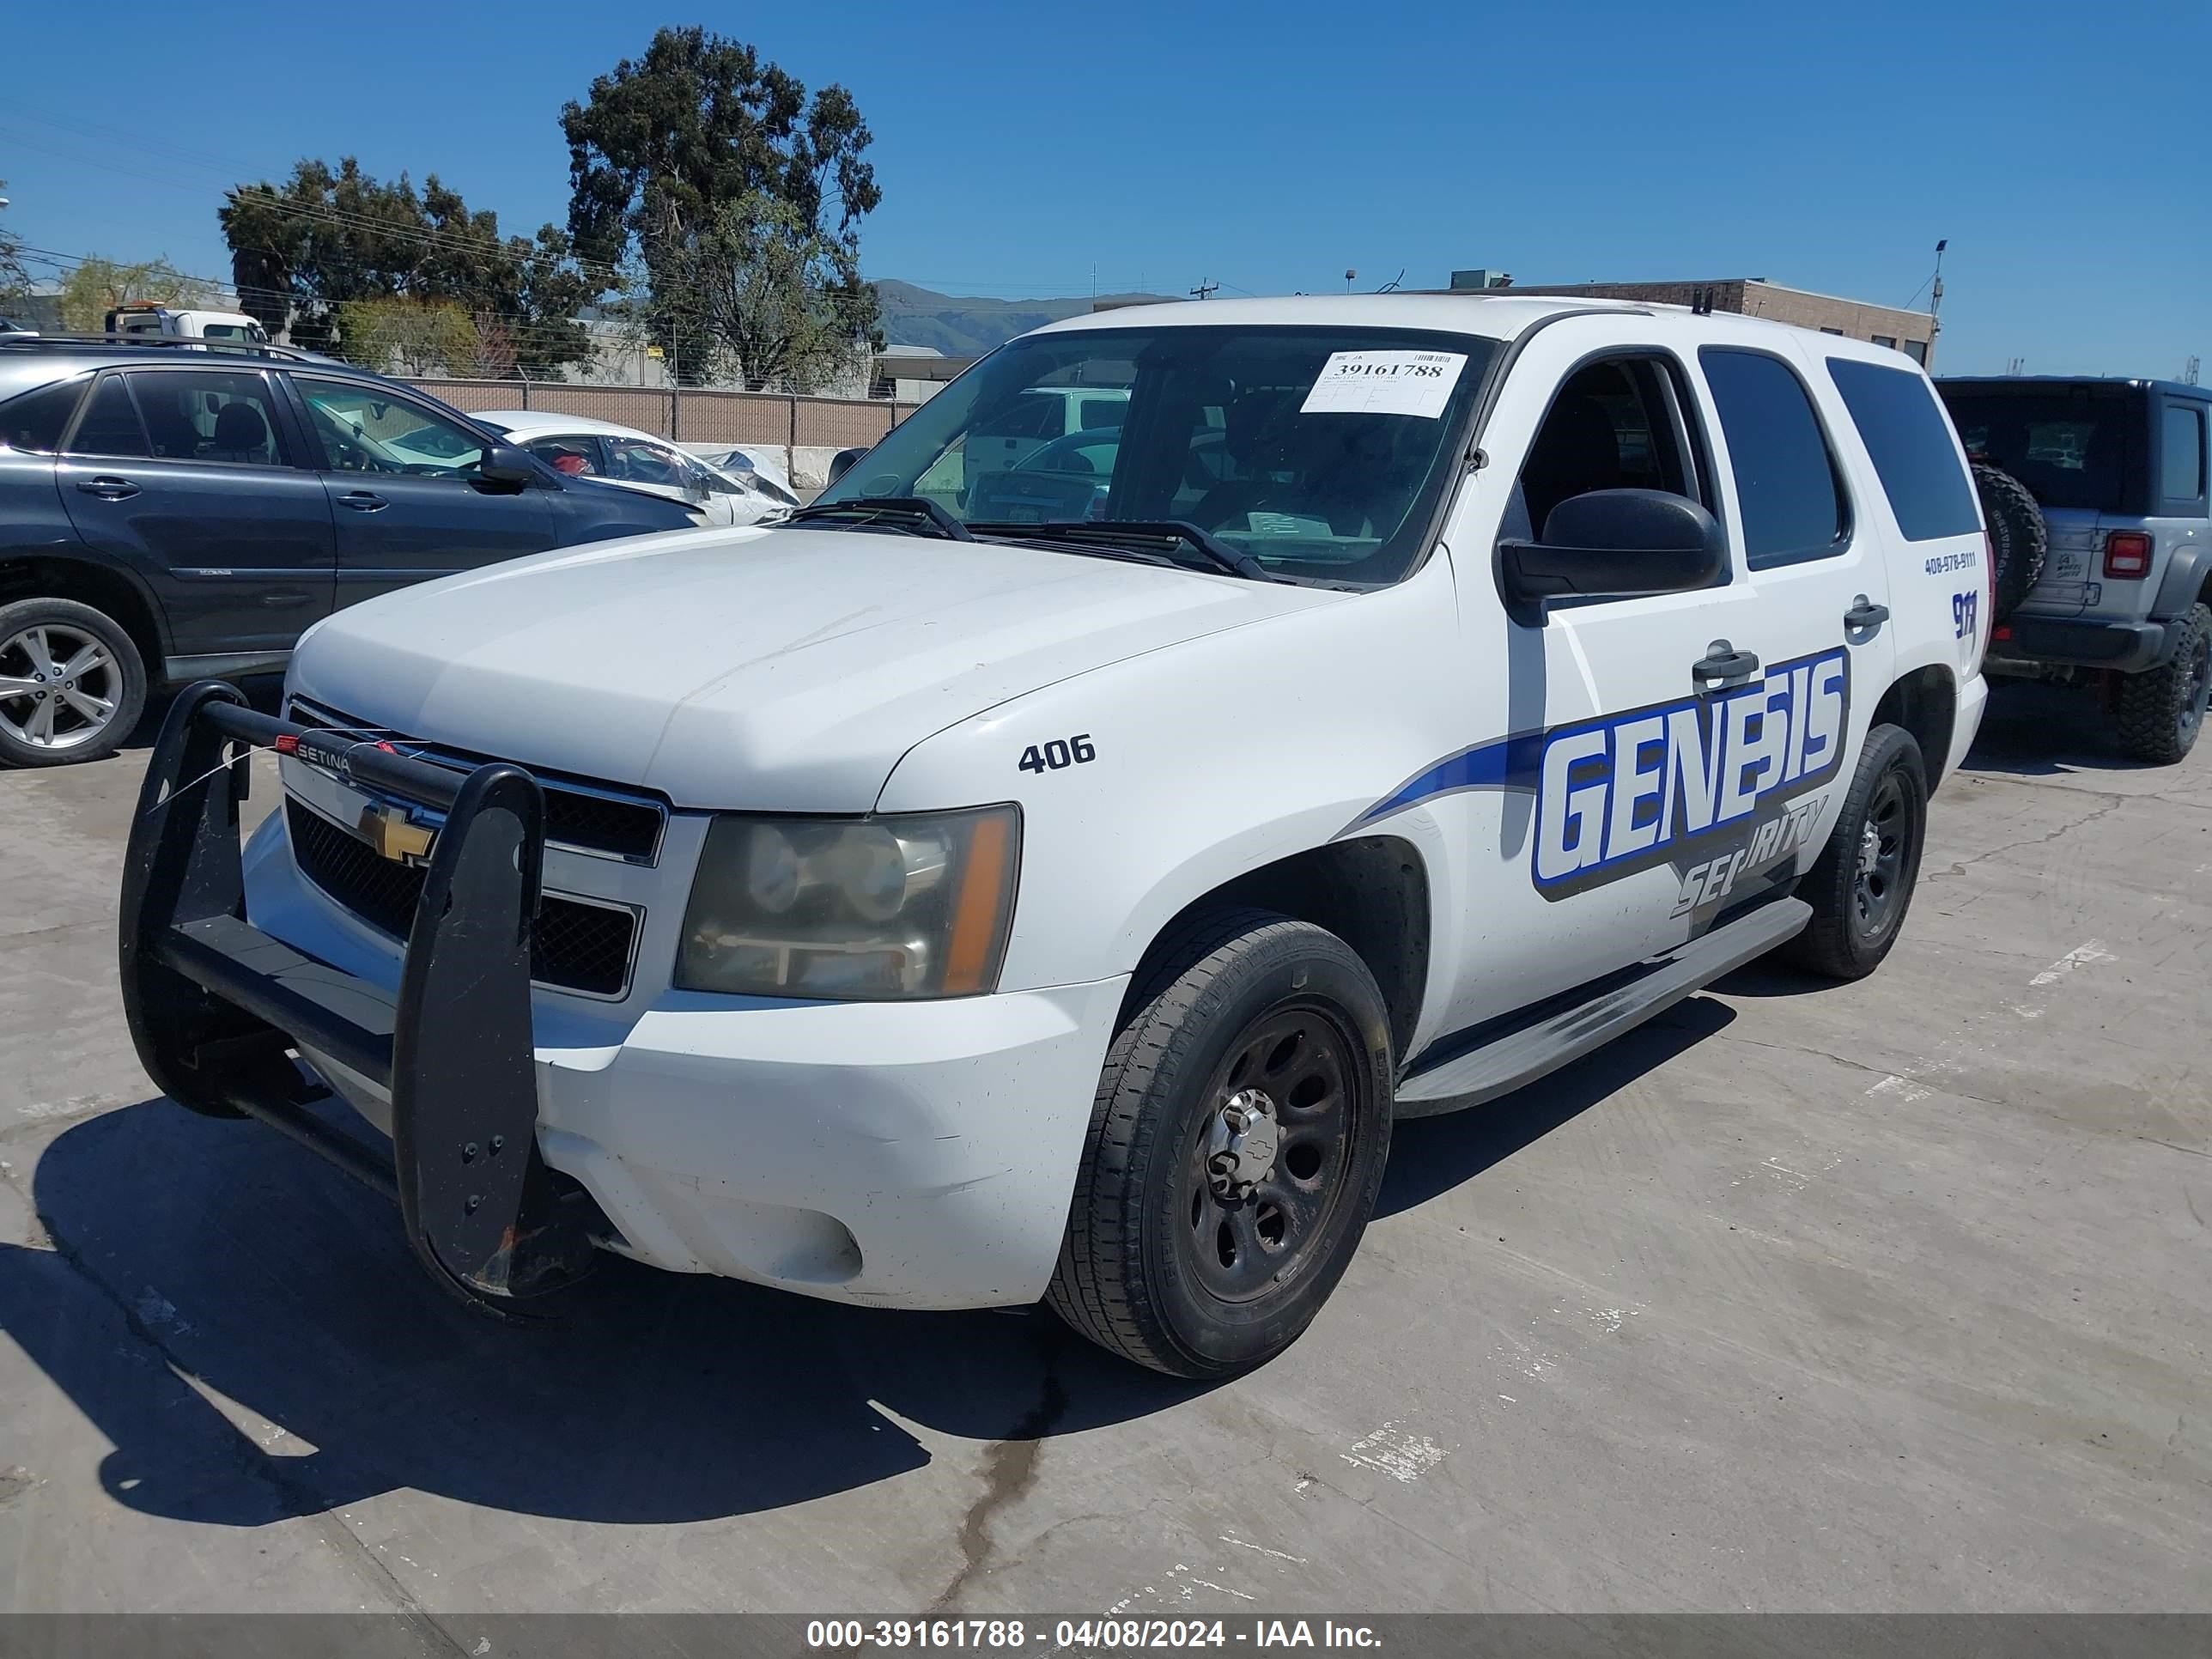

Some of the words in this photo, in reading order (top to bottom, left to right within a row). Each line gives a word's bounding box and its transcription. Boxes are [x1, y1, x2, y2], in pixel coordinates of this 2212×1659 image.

[1334, 363, 1443, 379] 39161788
[1924, 551, 1977, 575] 408-978-9111
[297, 744, 351, 773] SETINA
[1018, 732, 1096, 775] 406
[1536, 657, 1844, 880] GENESIS
